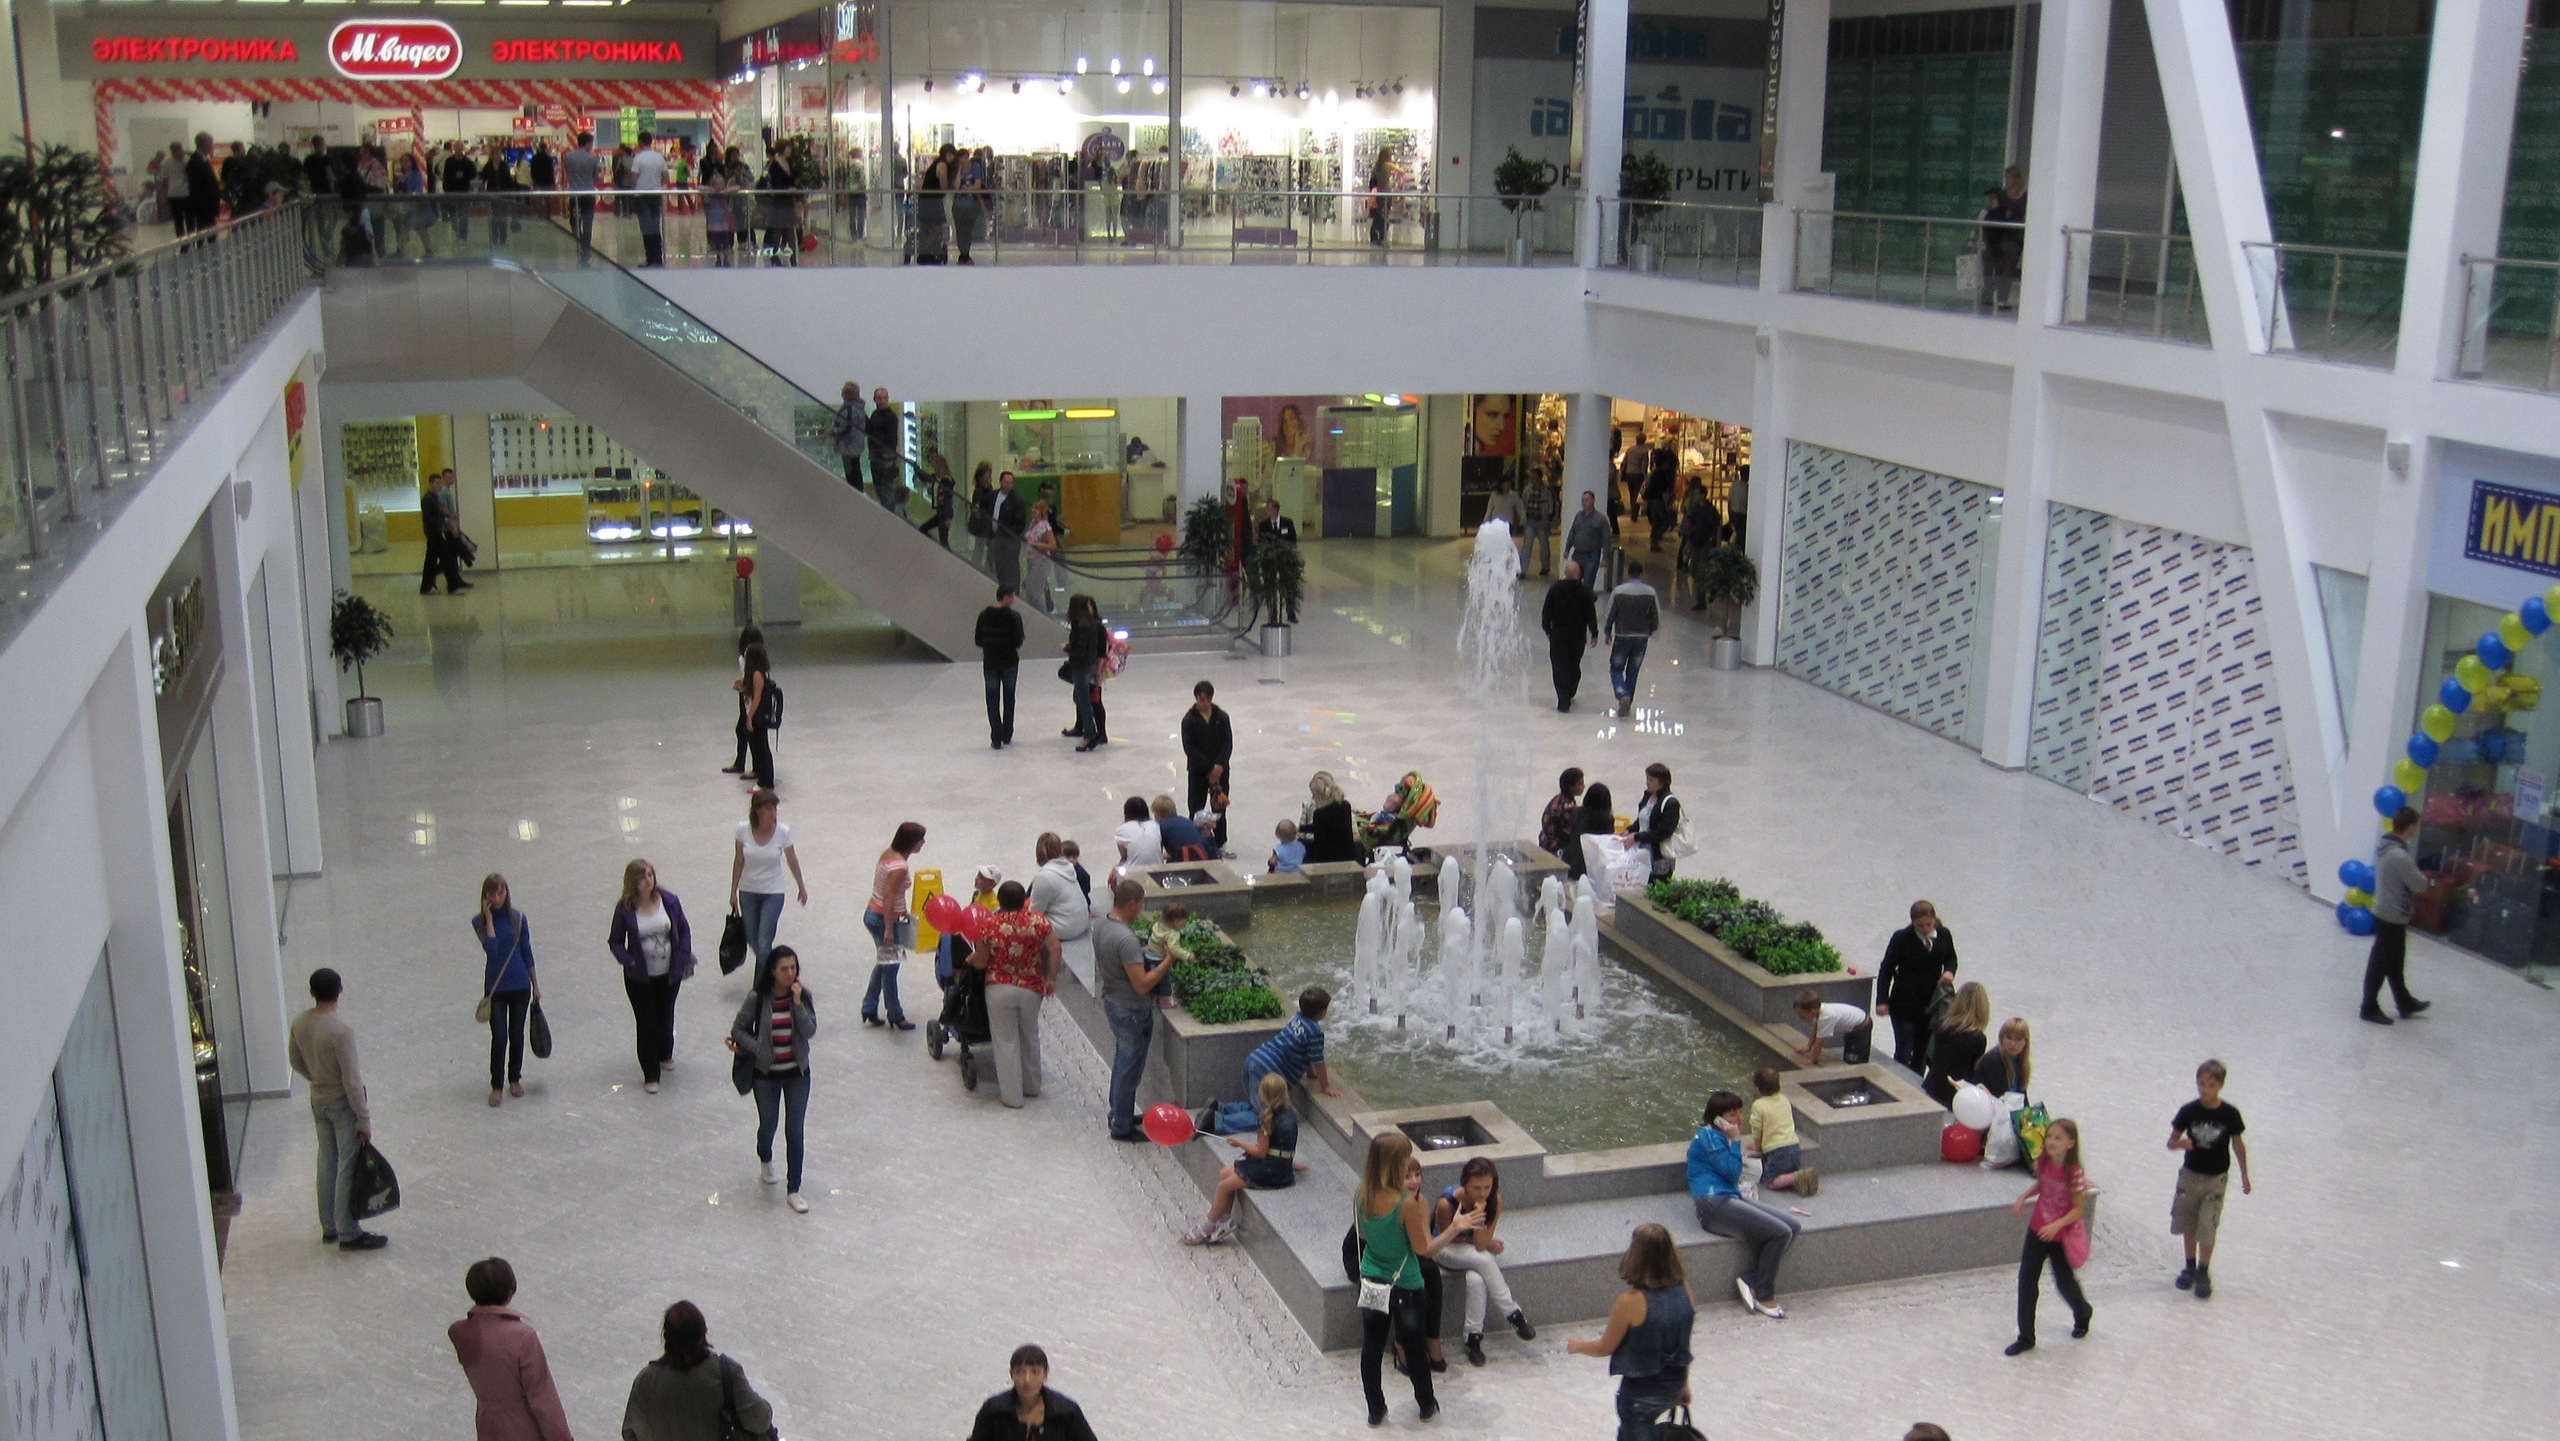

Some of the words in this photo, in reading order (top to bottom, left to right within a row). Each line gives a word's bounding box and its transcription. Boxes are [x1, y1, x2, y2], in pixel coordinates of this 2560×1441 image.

[92, 37, 299, 62] ЭЛЕКТРОНИКА
[491, 39, 684, 63] ЭЛЕКТРОНИКА
[1574, 36, 1586, 97] ARLO
